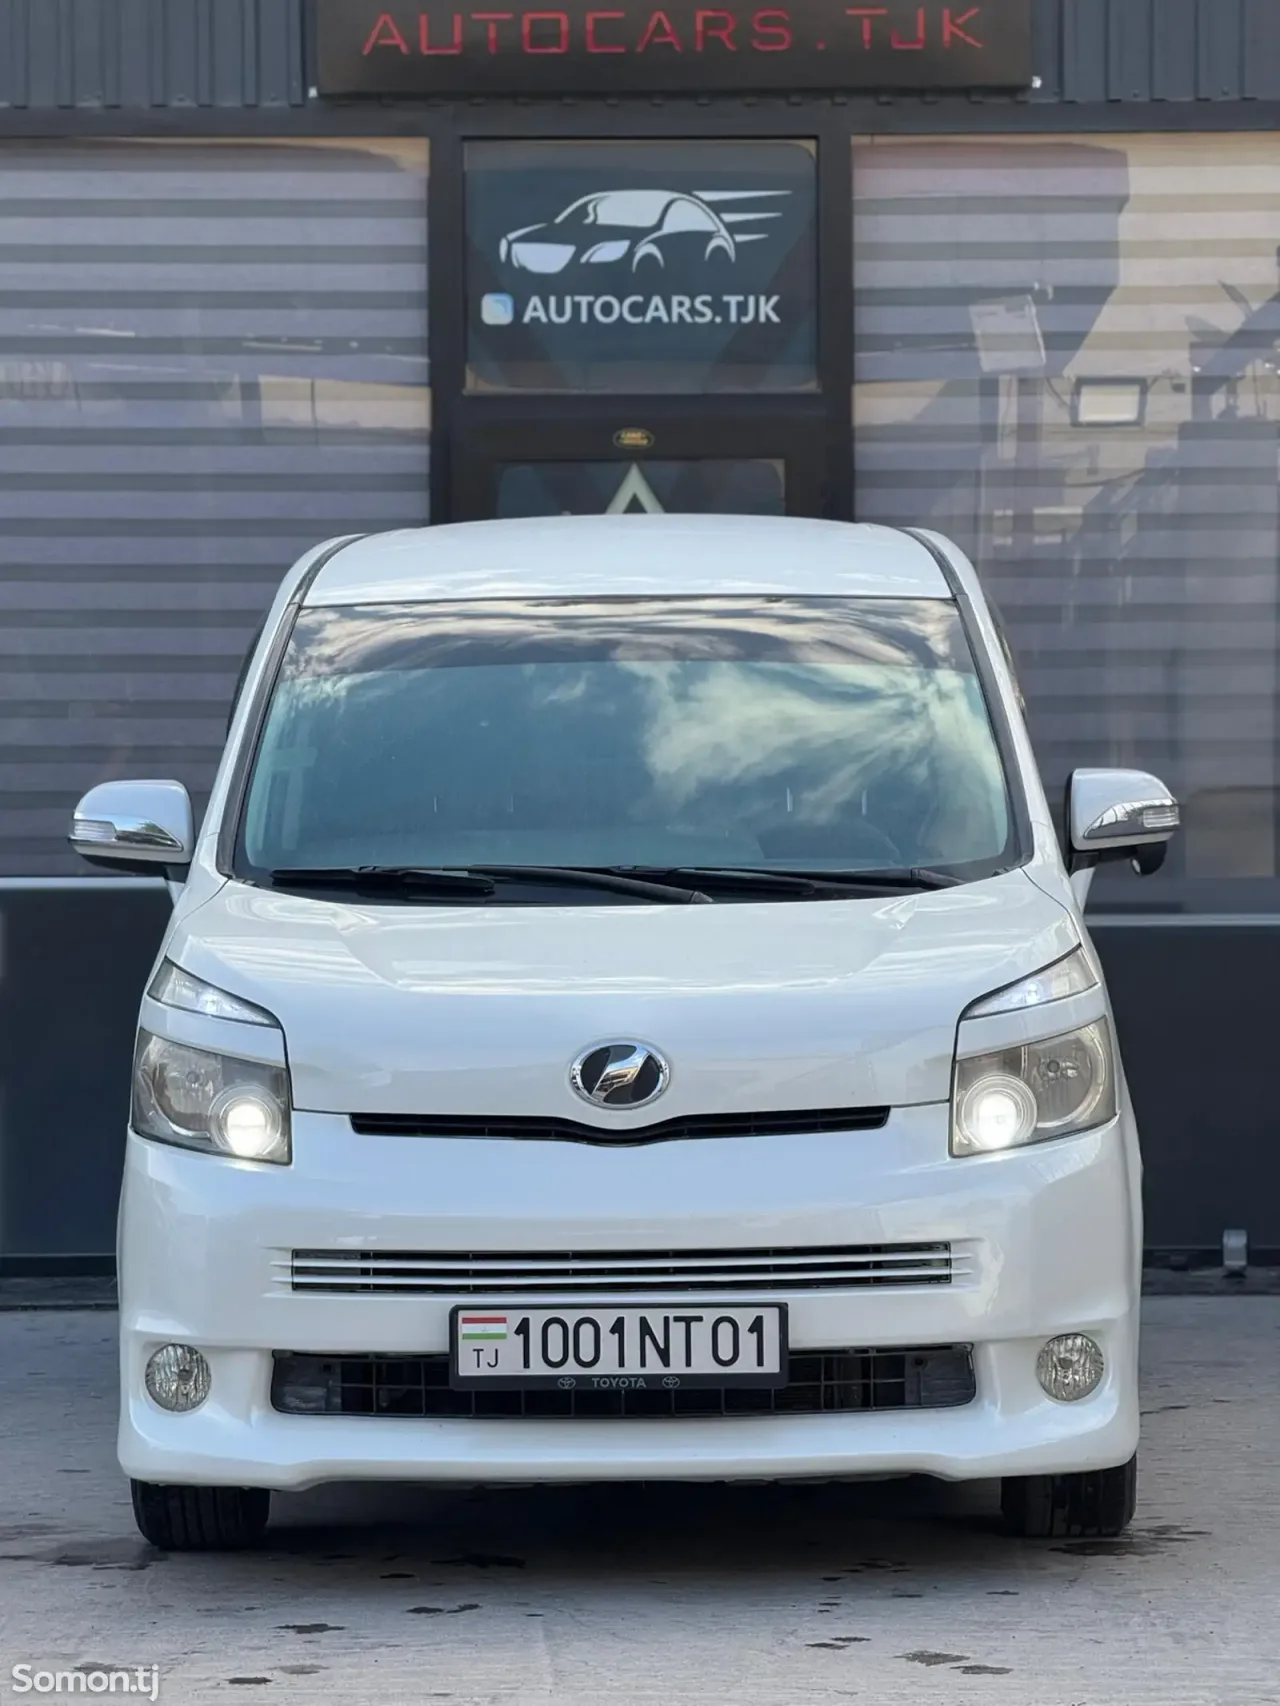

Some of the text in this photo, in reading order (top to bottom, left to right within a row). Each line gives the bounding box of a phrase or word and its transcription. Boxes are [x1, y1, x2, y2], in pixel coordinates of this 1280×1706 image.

[522, 294, 781, 325] AUTOCARS.TJK
[473, 1348, 499, 1368] TJ
[591, 1377, 646, 1388] TOYOTA
